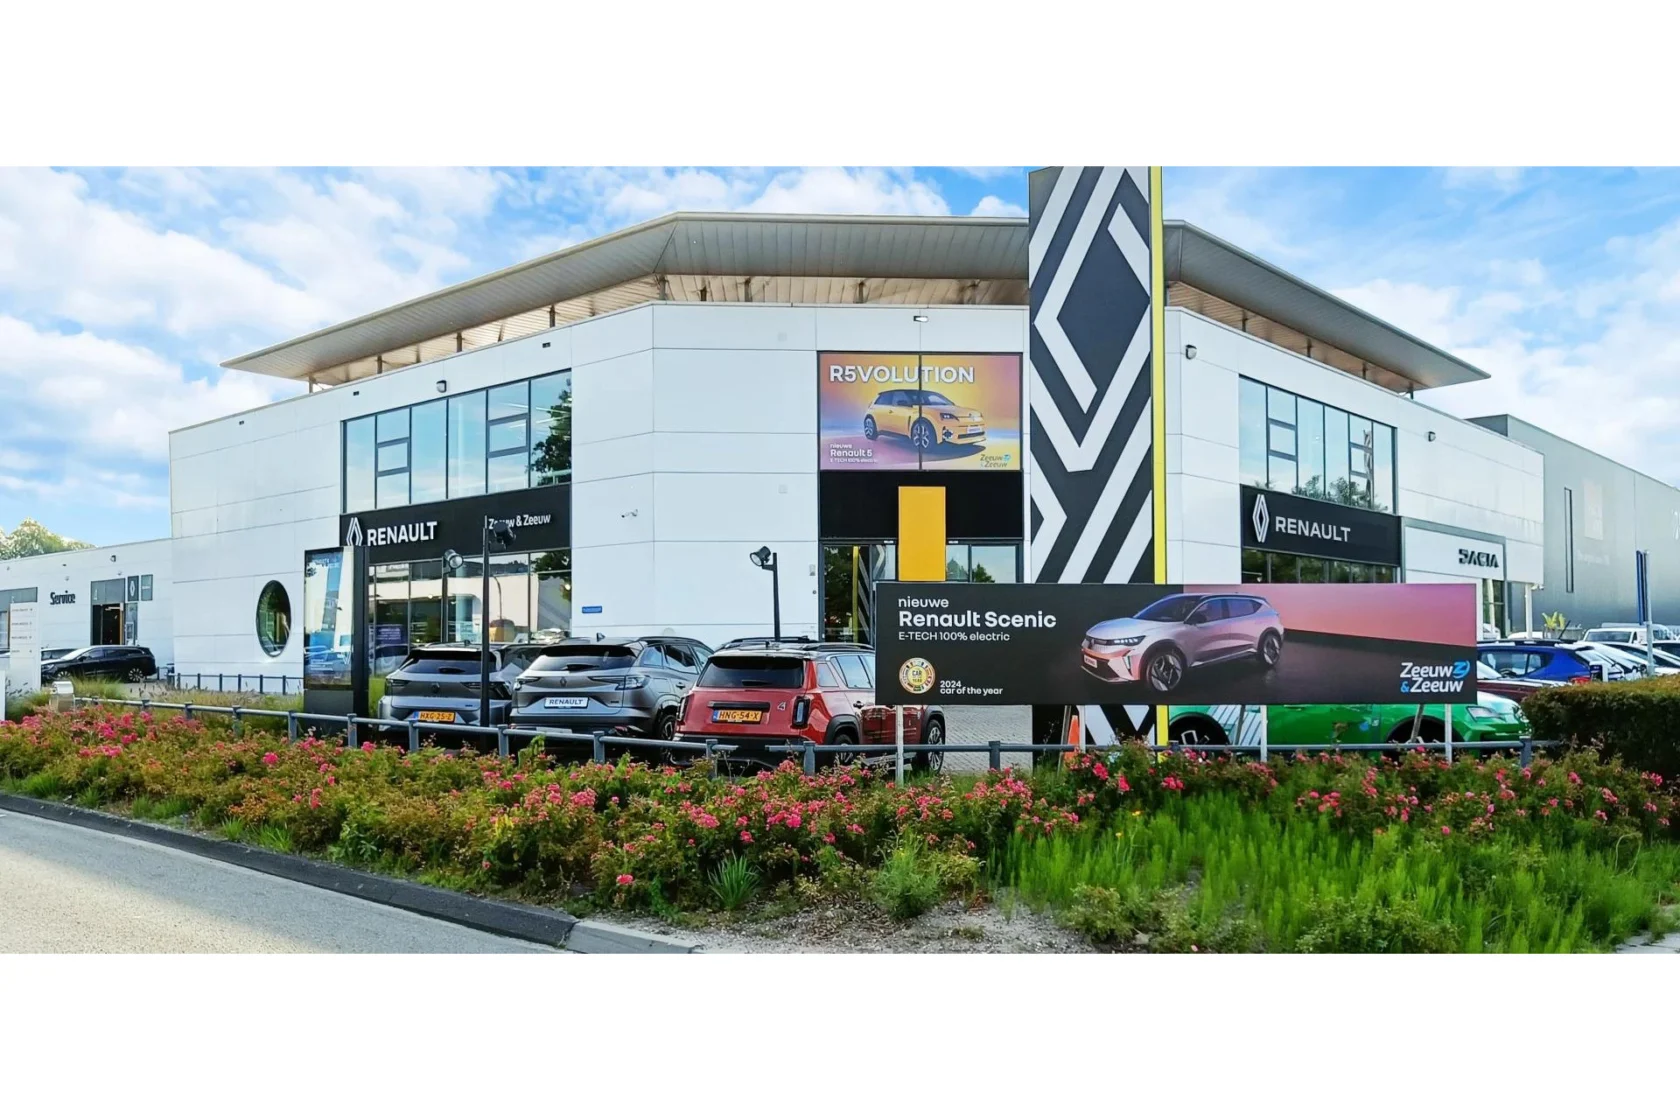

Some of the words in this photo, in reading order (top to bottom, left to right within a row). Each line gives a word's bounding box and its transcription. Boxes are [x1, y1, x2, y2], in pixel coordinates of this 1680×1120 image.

[829, 365, 975, 383] R5VOLUTION
[830, 448, 866, 457] Renault
[866, 449, 873, 457] 5
[980, 454, 1003, 463] Zeeuw
[516, 515, 522, 527] &
[523, 514, 551, 526] Zeeuw
[366, 520, 438, 546] RENAULT
[1275, 516, 1351, 542] RENAULT
[50, 590, 76, 604] Service
[898, 596, 949, 608] nieuwe
[898, 610, 981, 628] Renault
[984, 610, 1057, 628] Scenic
[898, 631, 938, 641] E-TECH
[939, 631, 968, 641] 100%
[970, 631, 1010, 641] electric
[1400, 662, 1453, 680] Zeeuw
[939, 680, 962, 688] 2024
[939, 687, 955, 695] car
[956, 686, 966, 695] of
[967, 687, 982, 695] the
[983, 688, 1003, 696] year
